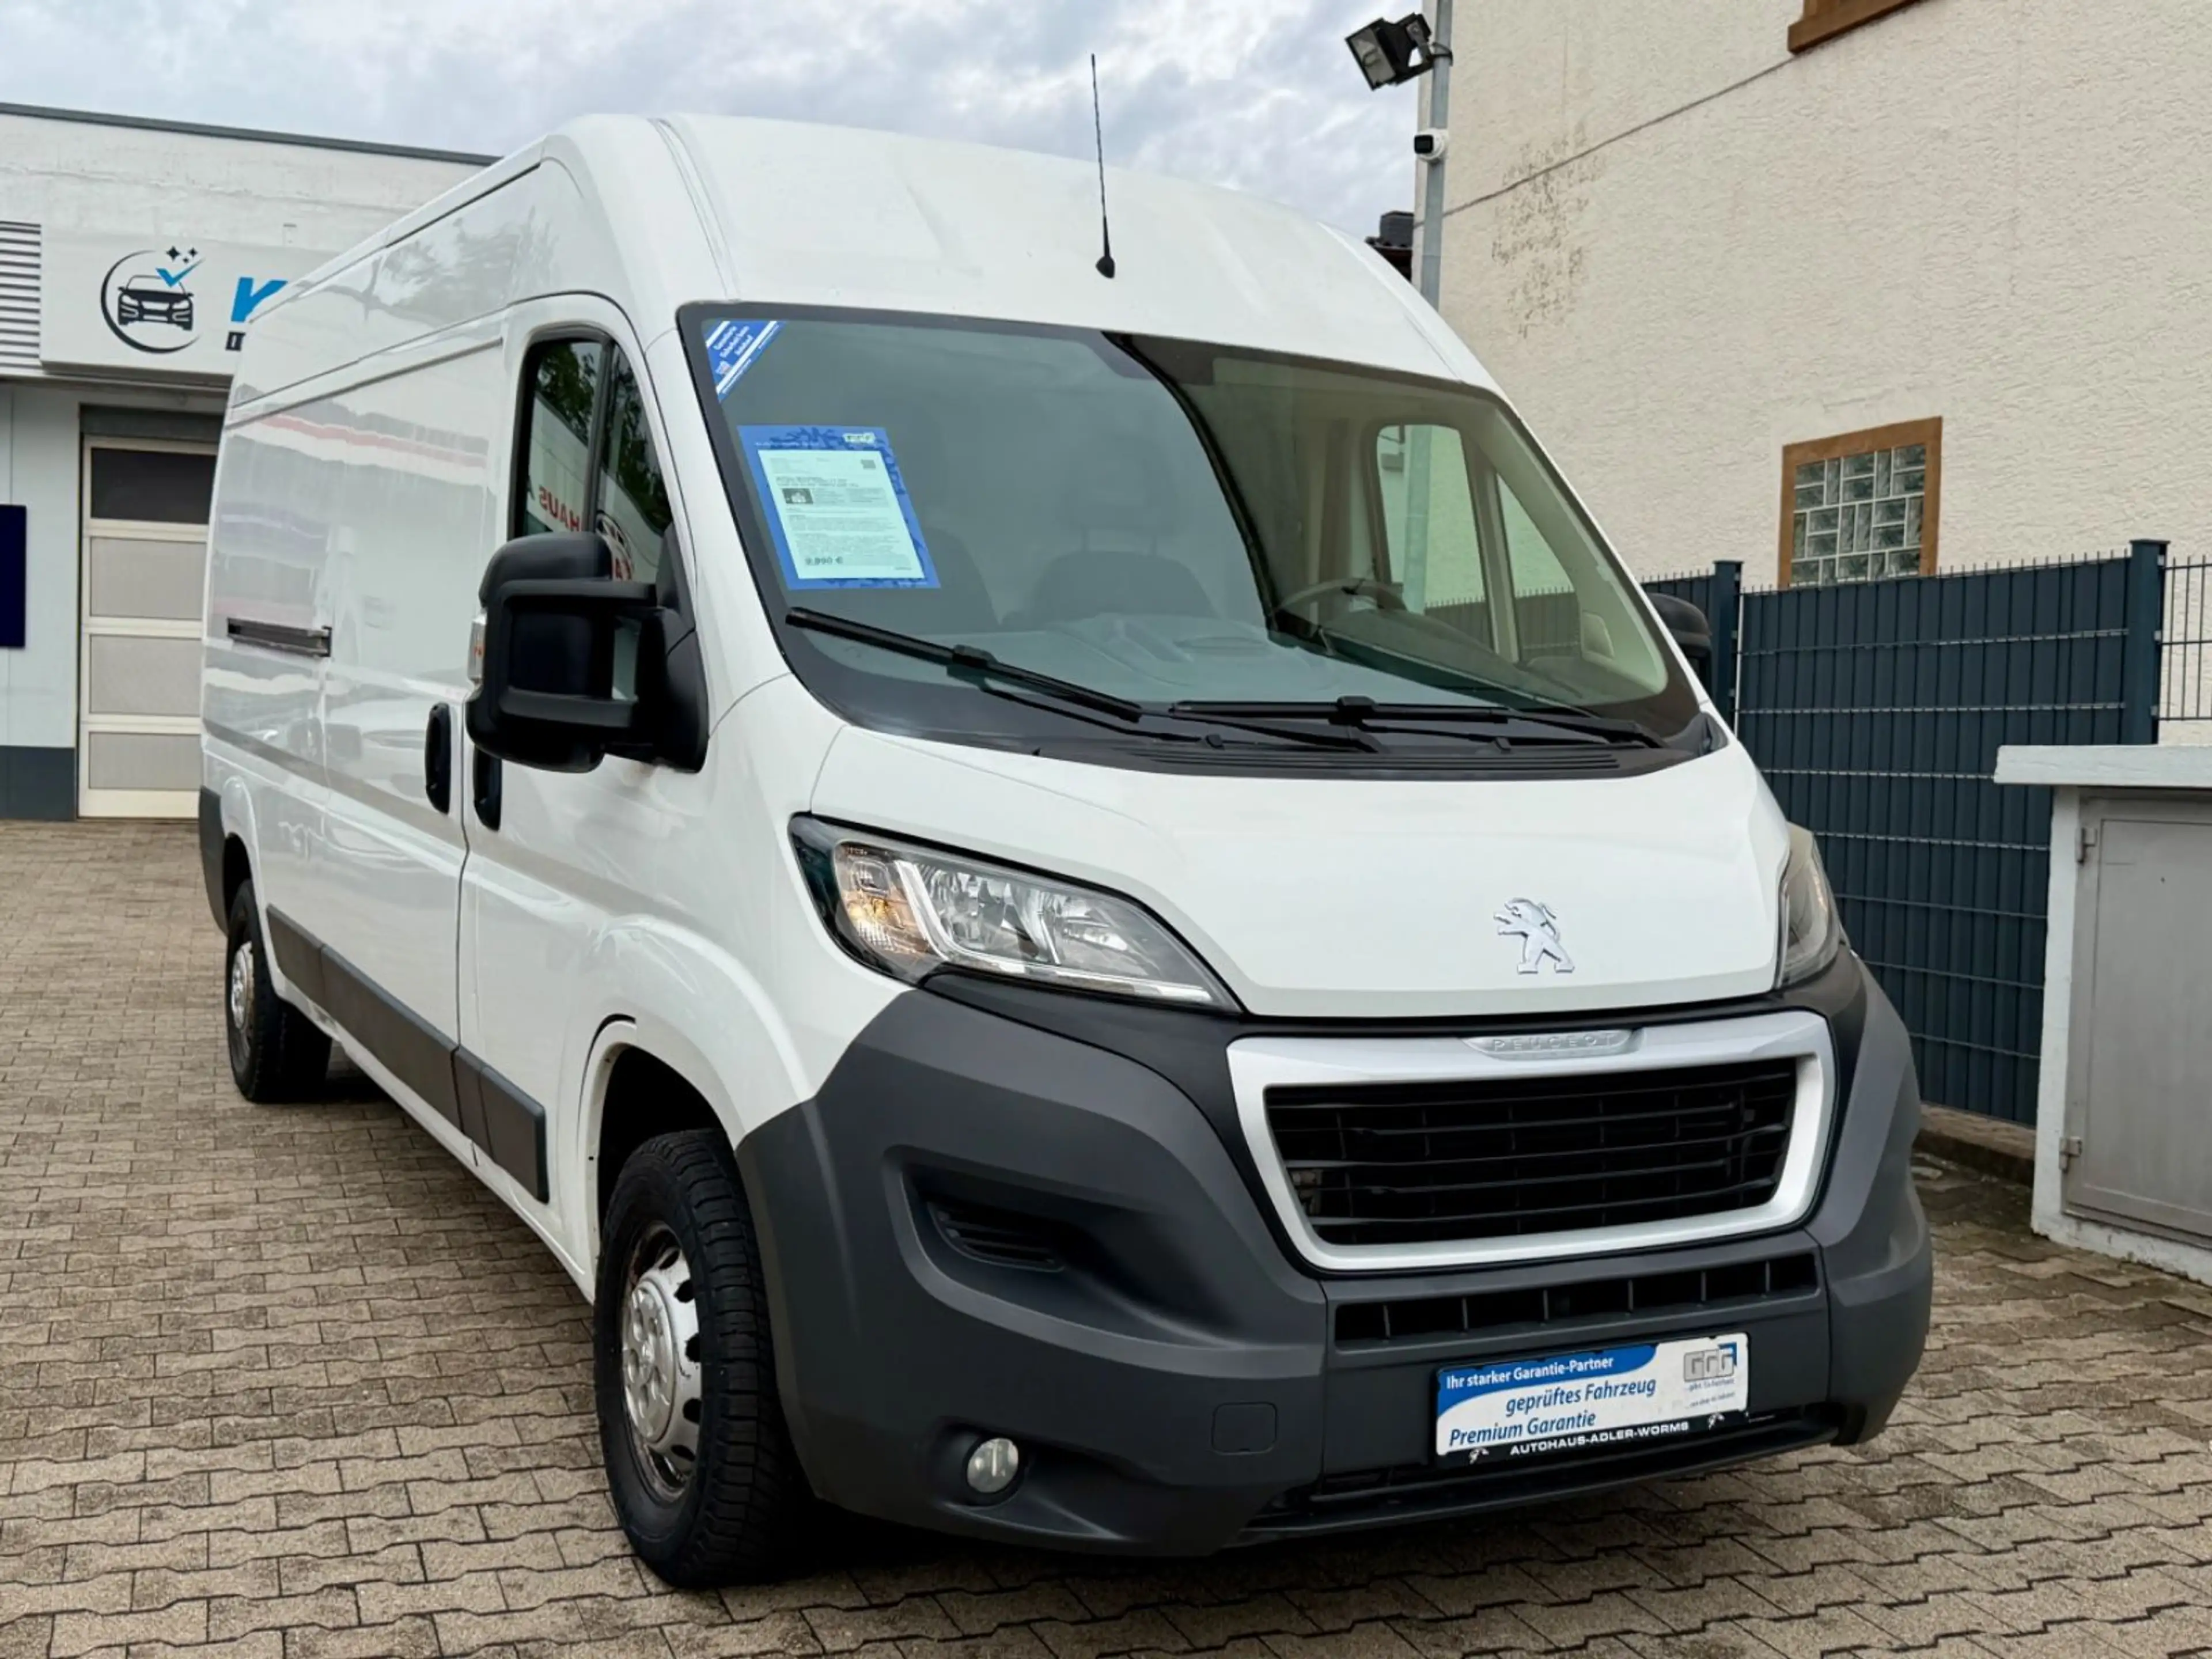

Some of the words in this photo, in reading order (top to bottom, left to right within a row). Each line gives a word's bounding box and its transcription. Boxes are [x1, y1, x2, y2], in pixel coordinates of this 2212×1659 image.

[1494, 1032, 1616, 1052] PEUGEOT
[1446, 1374, 1465, 1389] Ihr
[1467, 1369, 1511, 1387] starker
[1513, 1357, 1614, 1380] Garantie-Partner
[1505, 1385, 1581, 1418] geprüftes
[1585, 1378, 1657, 1397] Fahrzeug
[1449, 1422, 1522, 1446] Premium
[1527, 1410, 1597, 1437] Garantie
[1510, 1421, 1690, 1456] AUTOHAUS-ADLER-WORMS
